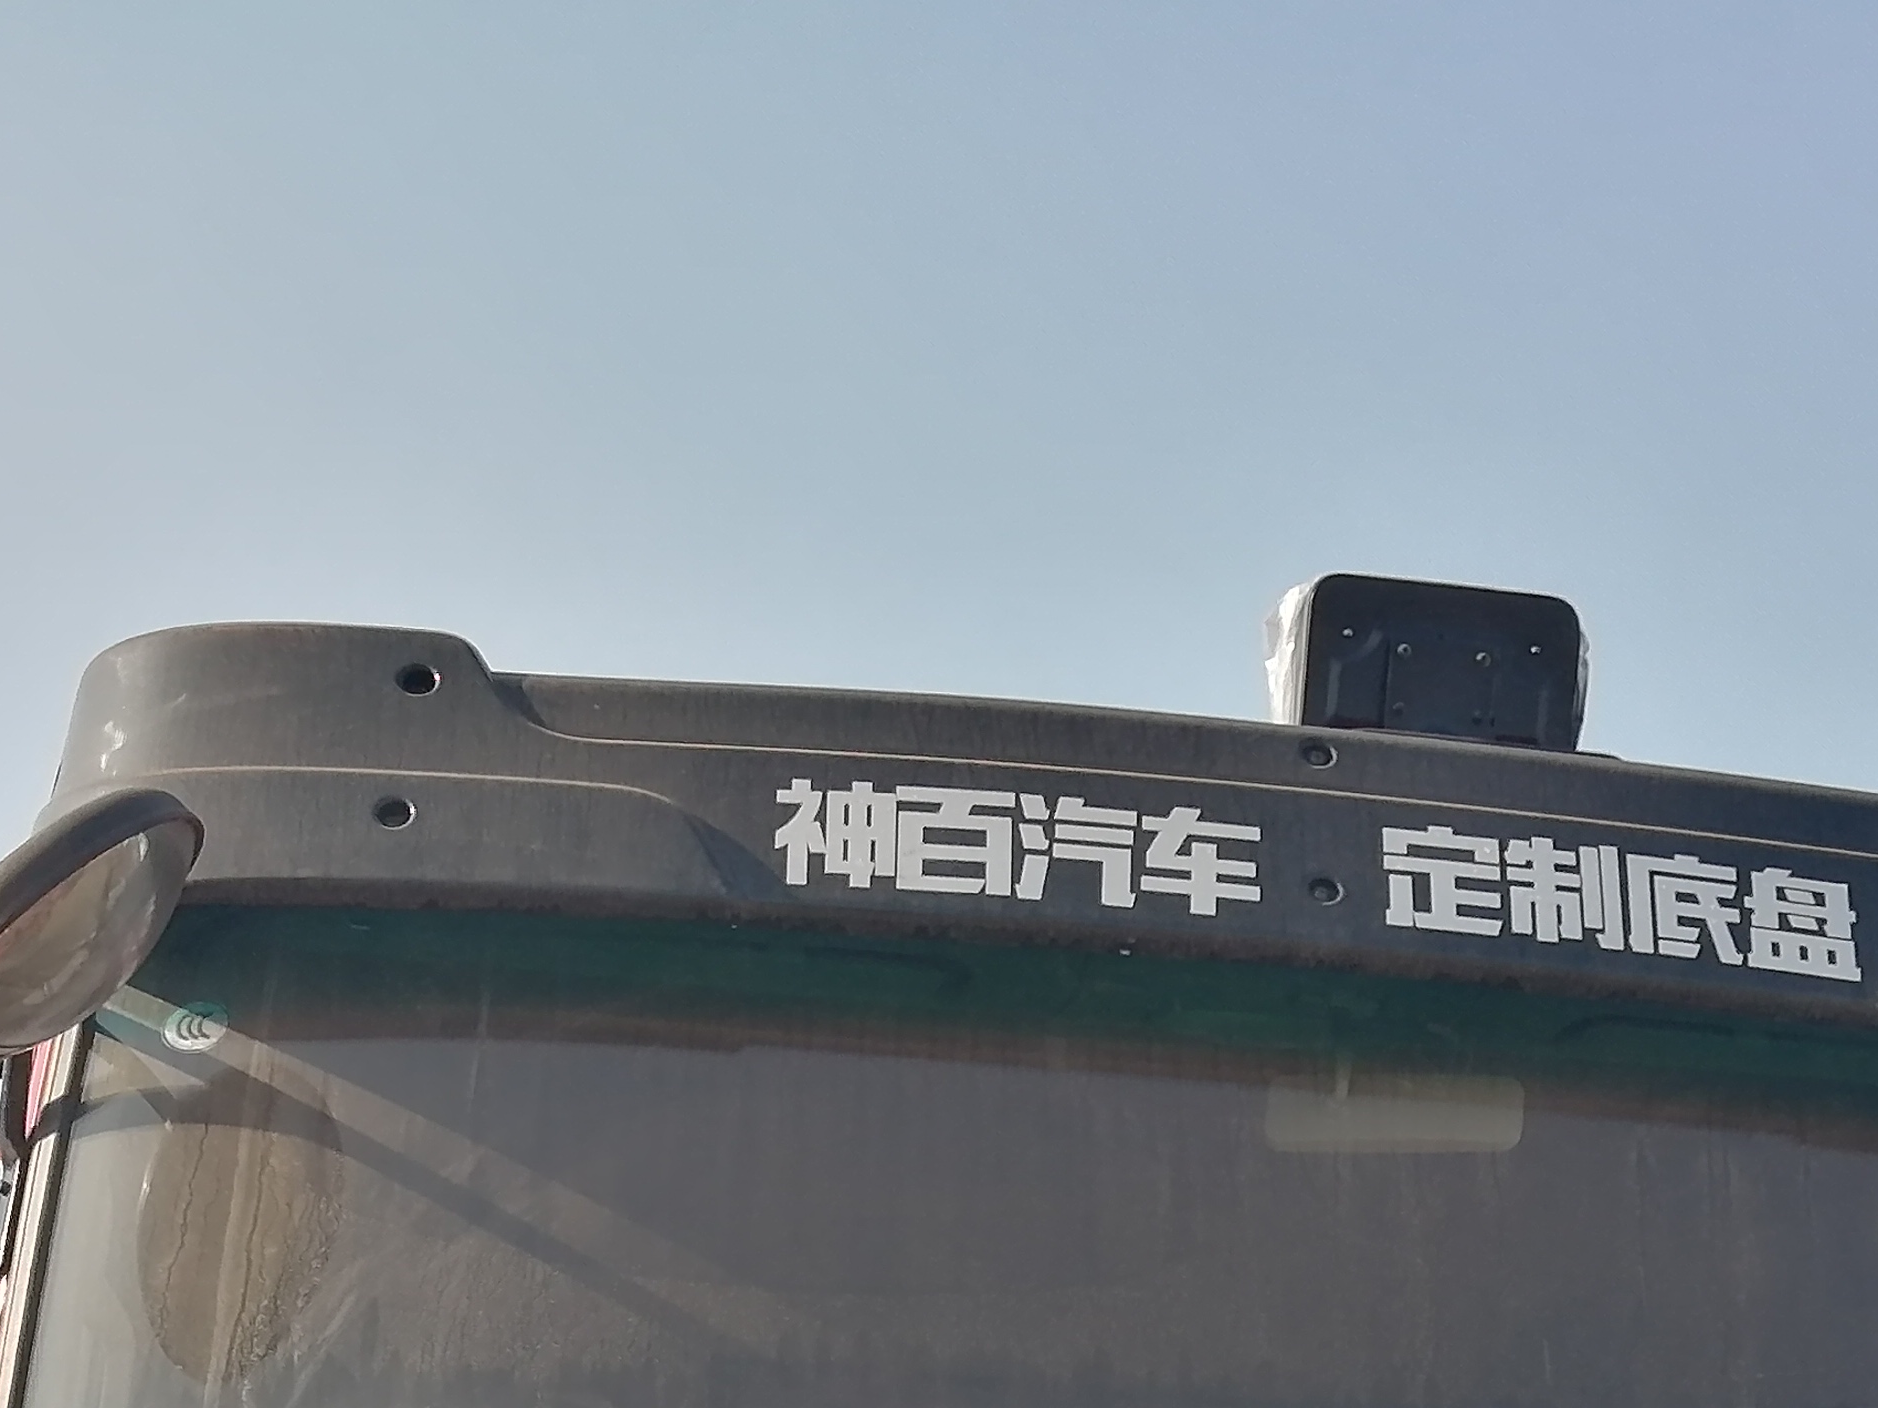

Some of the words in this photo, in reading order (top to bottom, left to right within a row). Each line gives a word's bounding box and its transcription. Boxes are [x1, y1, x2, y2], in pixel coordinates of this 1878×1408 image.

[775, 777, 1262, 916] 神百汽车
[1381, 824, 1862, 983] 定制底盘
